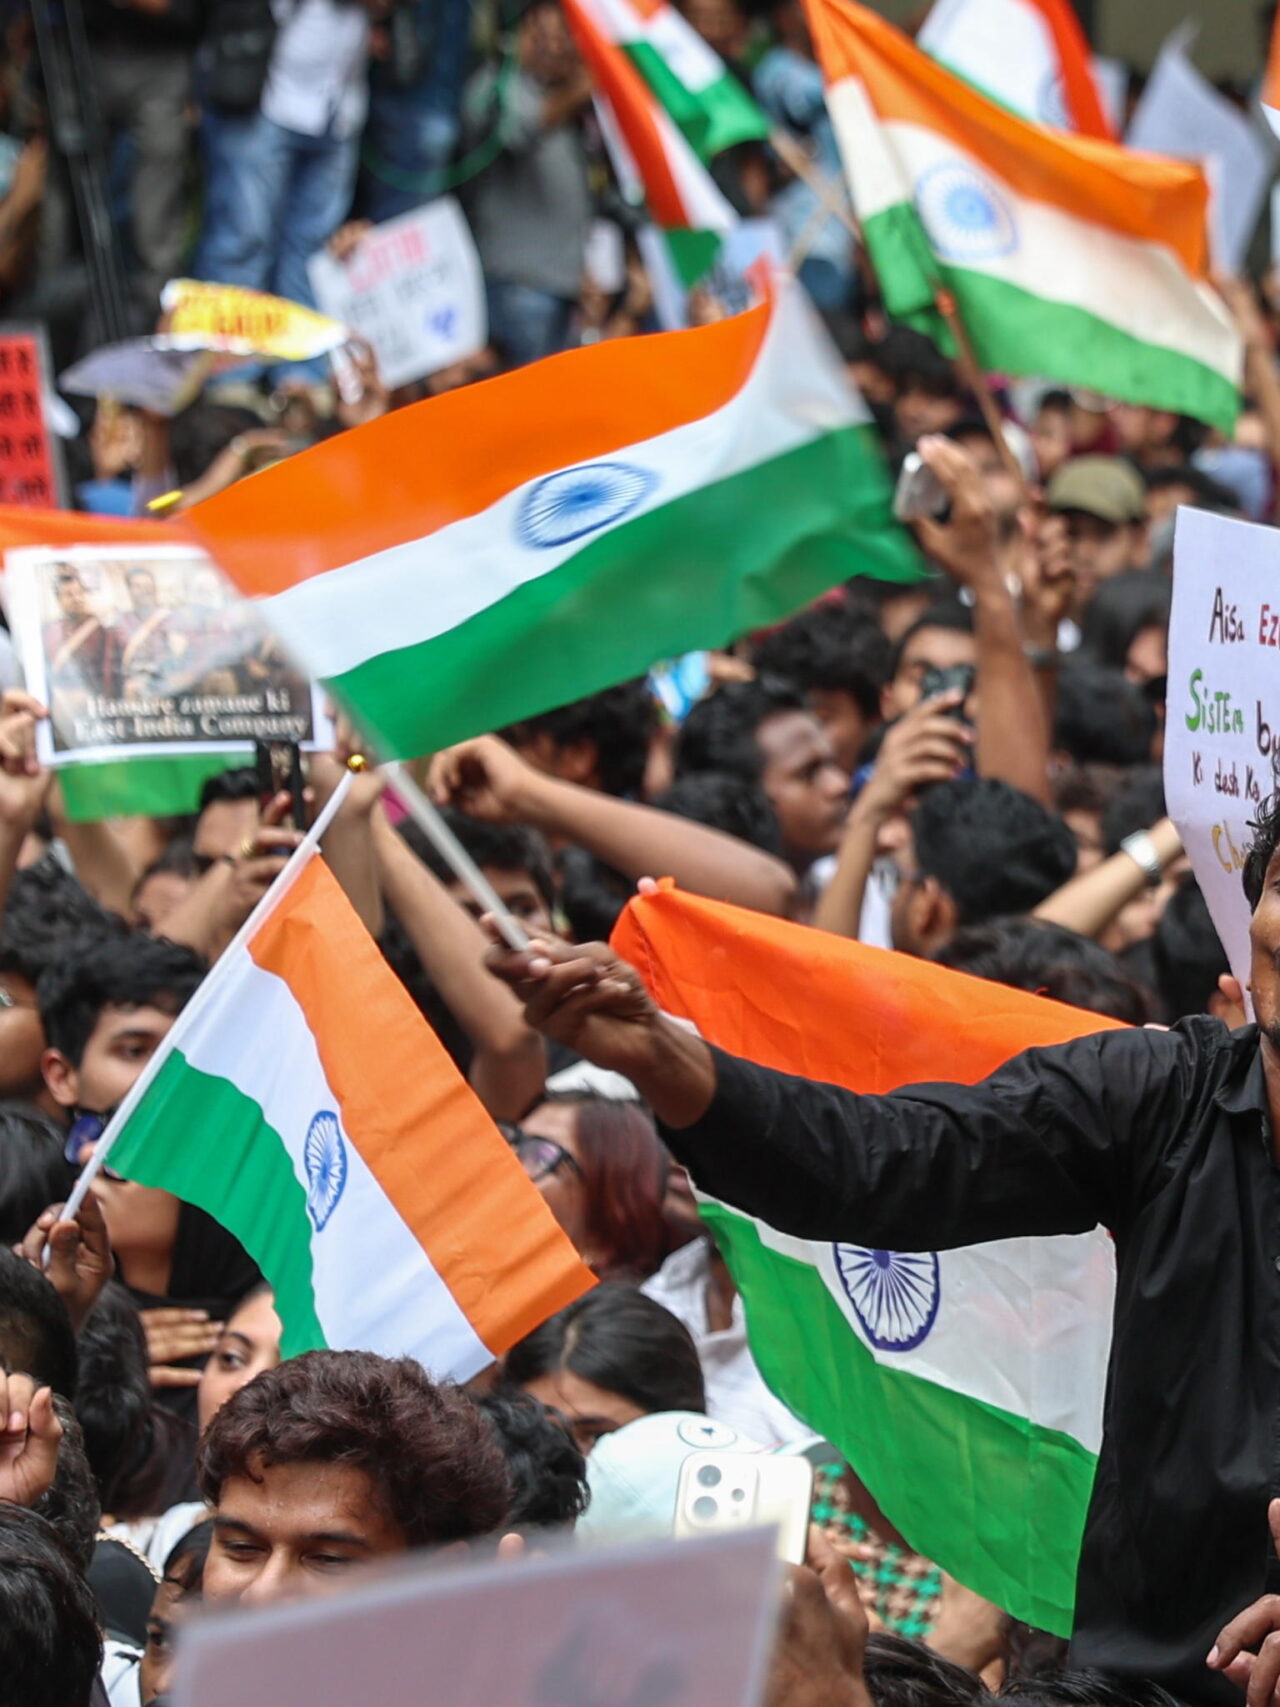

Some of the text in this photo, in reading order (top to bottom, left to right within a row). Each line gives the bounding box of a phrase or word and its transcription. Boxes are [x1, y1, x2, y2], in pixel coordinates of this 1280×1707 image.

[266, 688, 290, 713] ki
[133, 715, 195, 738] India
[200, 715, 308, 738] Company
